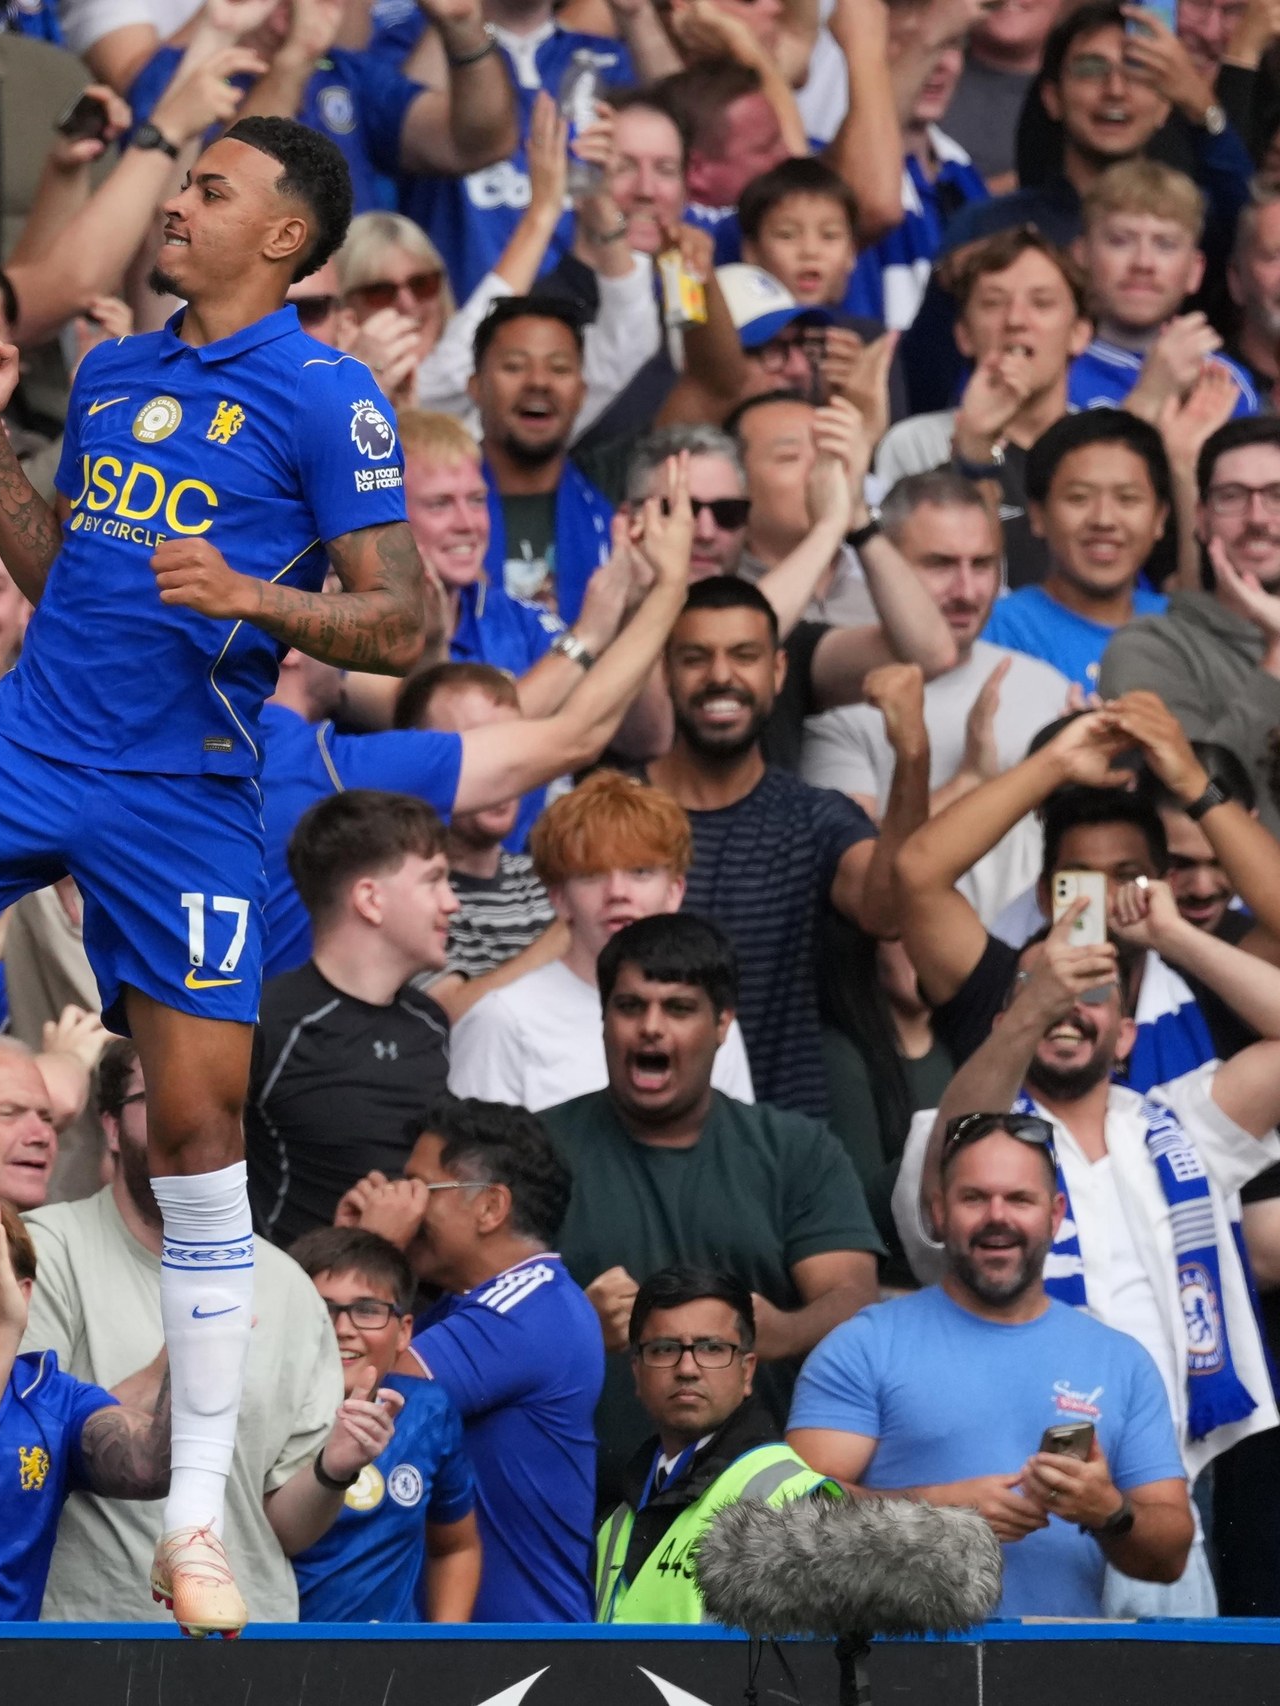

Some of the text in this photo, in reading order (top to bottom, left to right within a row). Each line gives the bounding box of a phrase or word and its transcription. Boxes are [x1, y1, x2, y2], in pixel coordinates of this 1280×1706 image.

[137, 401, 157, 422] WORLD
[354, 467, 399, 482] No room
[84, 515, 102, 532] BY
[181, 893, 250, 972] 17
